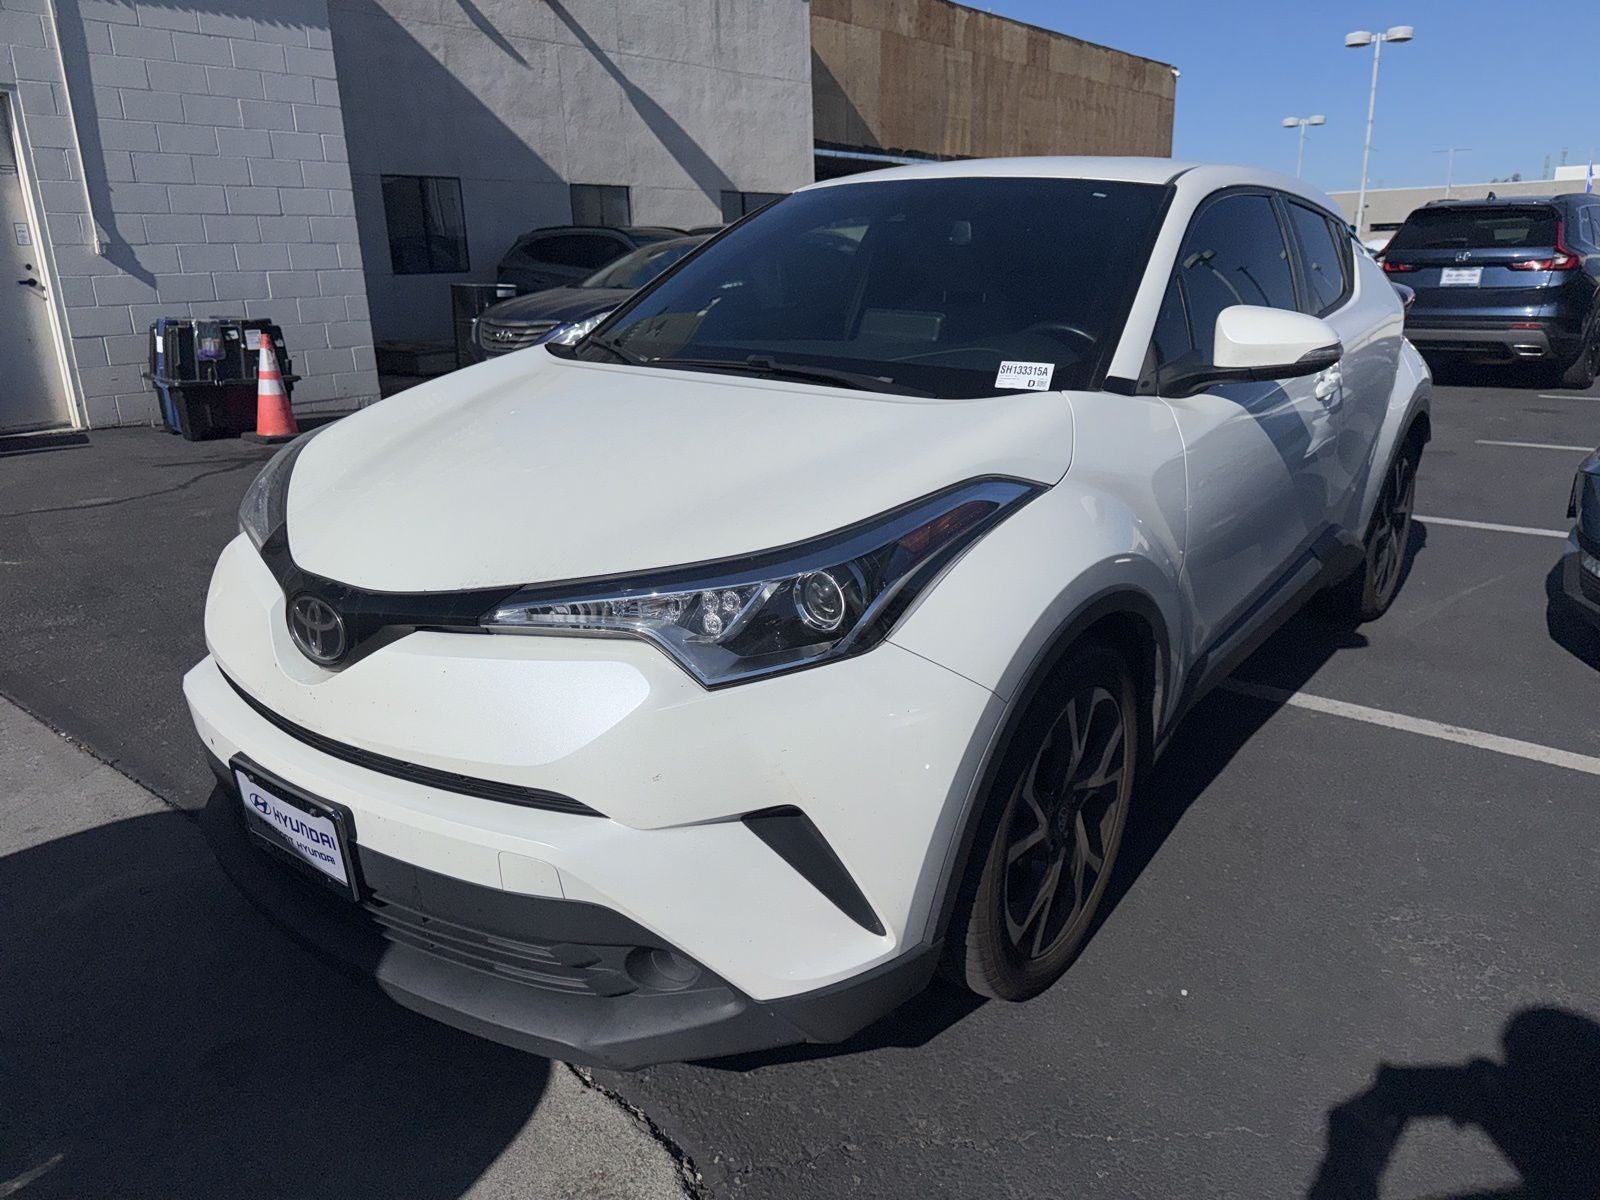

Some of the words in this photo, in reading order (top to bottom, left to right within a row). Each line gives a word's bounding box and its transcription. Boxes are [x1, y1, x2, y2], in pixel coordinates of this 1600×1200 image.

[1000, 365, 1048, 376] SH133315A
[1027, 379, 1036, 387] D
[273, 806, 337, 851] HYUNDAI
[296, 841, 336, 865] HYUNDAI
